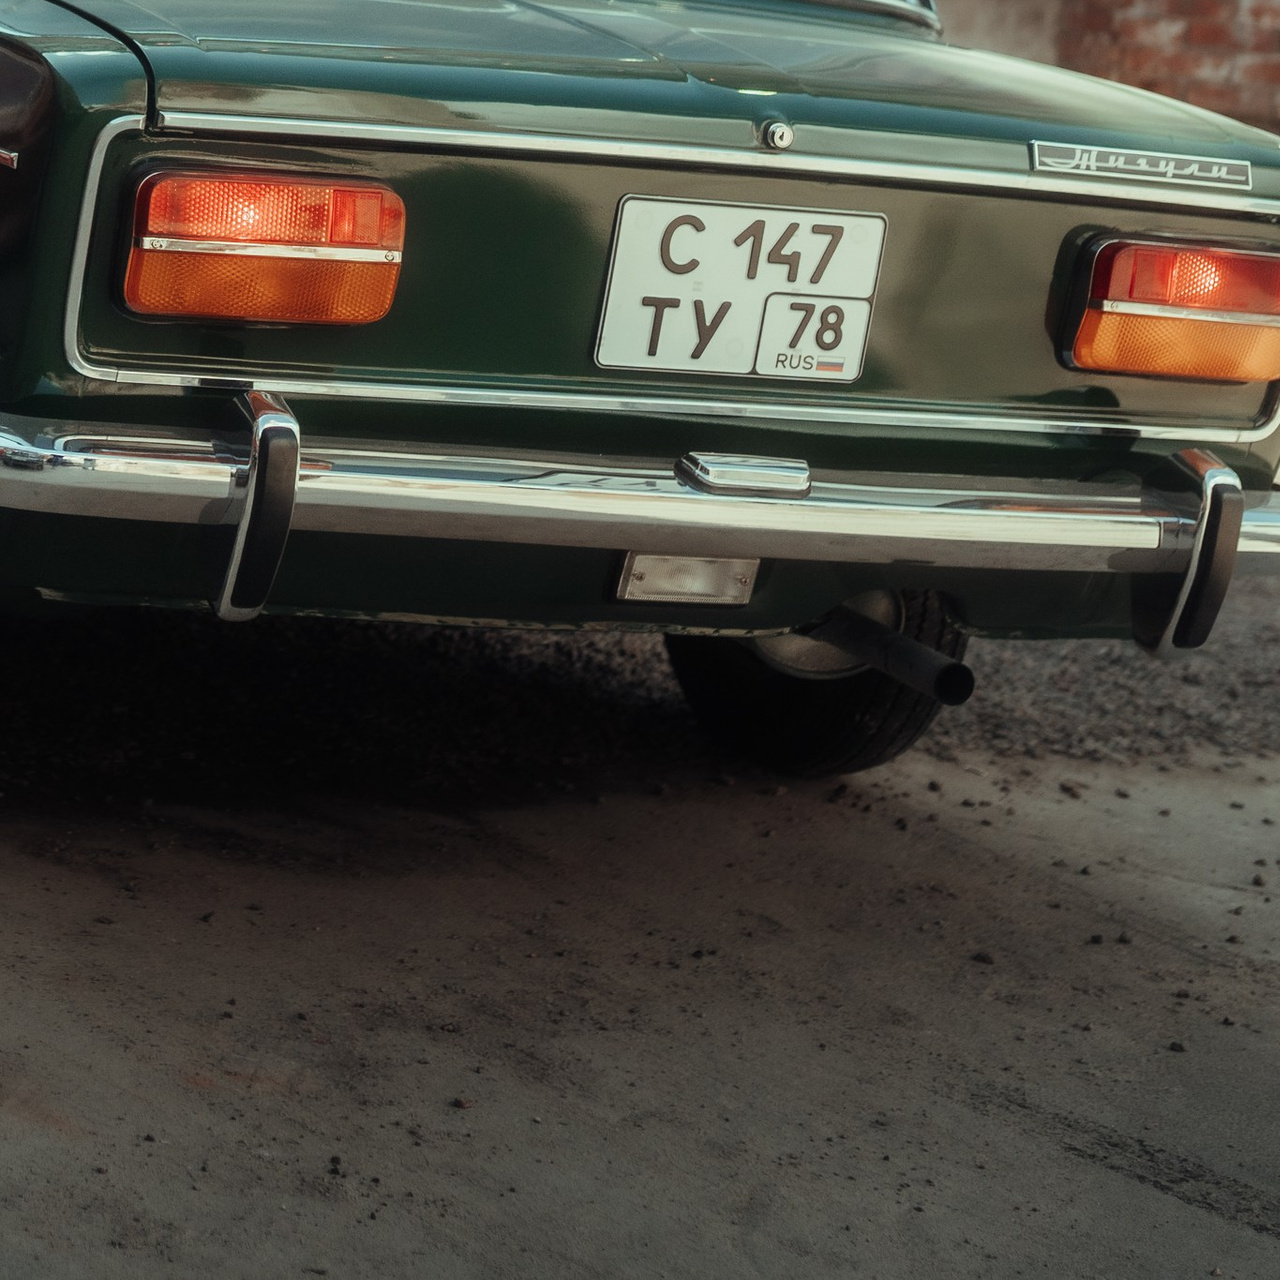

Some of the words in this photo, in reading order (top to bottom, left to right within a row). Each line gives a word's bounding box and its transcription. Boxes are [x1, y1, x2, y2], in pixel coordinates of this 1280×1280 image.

[733, 219, 844, 284] 147
[787, 302, 845, 351] 78
[775, 353, 815, 371] RUS
